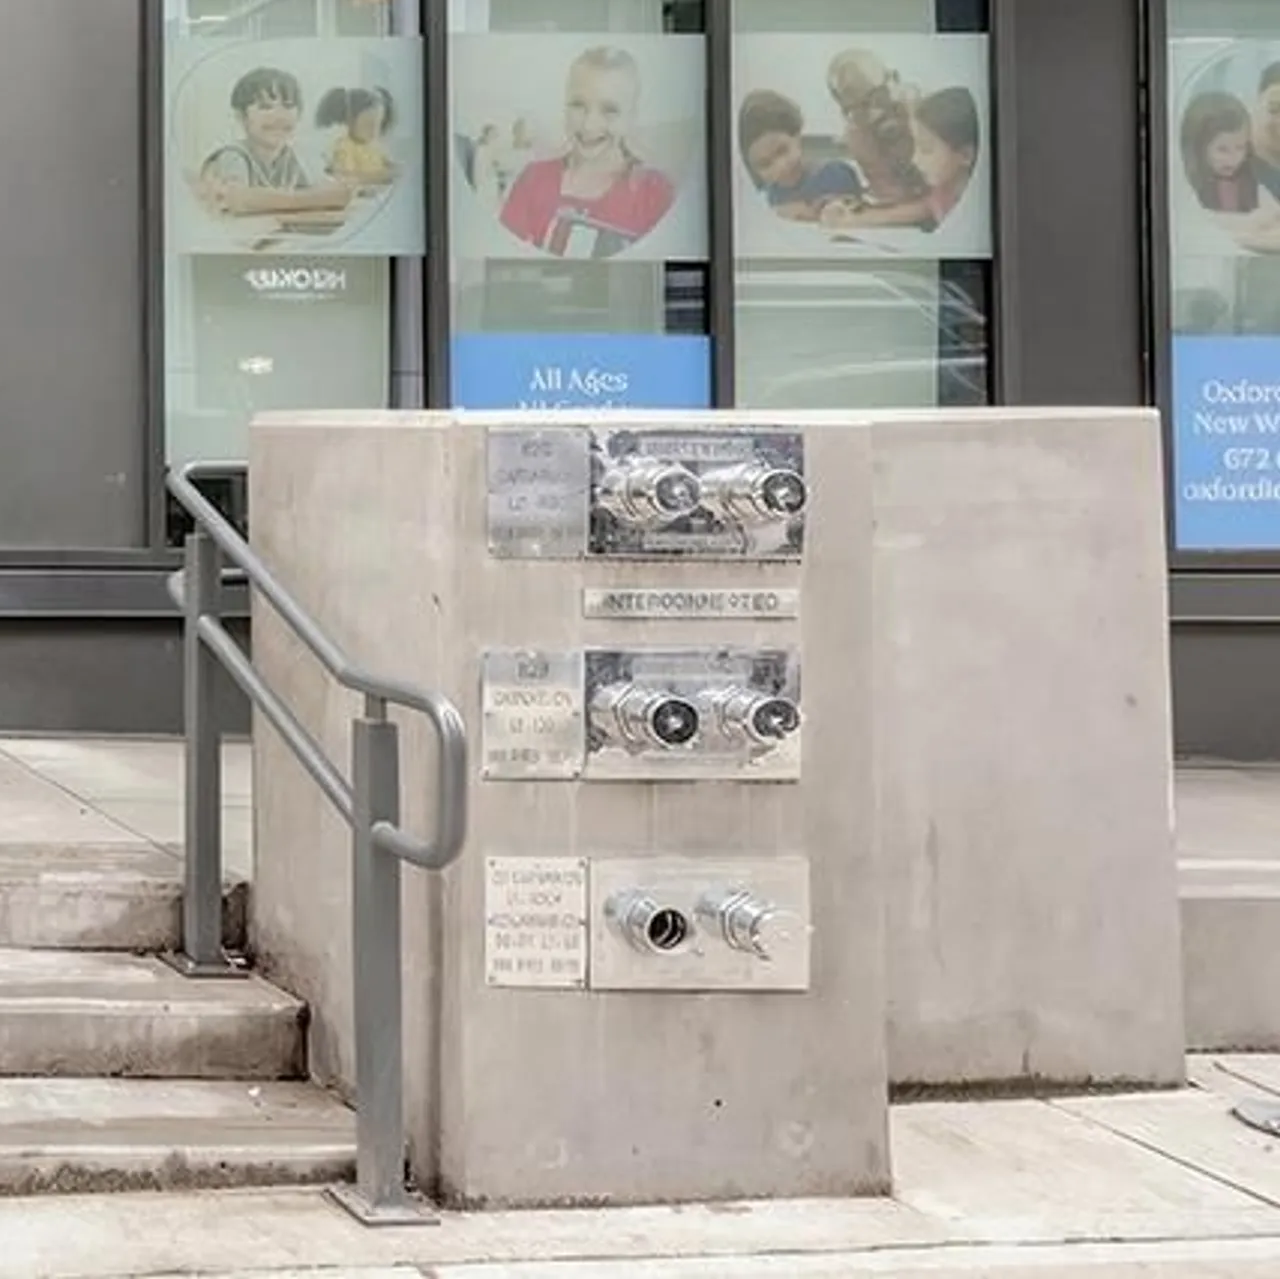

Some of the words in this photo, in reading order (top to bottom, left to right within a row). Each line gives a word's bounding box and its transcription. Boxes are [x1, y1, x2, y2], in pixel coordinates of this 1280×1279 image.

[530, 368, 561, 391] All
[568, 368, 629, 397] Ages
[1223, 448, 1270, 470] 672
